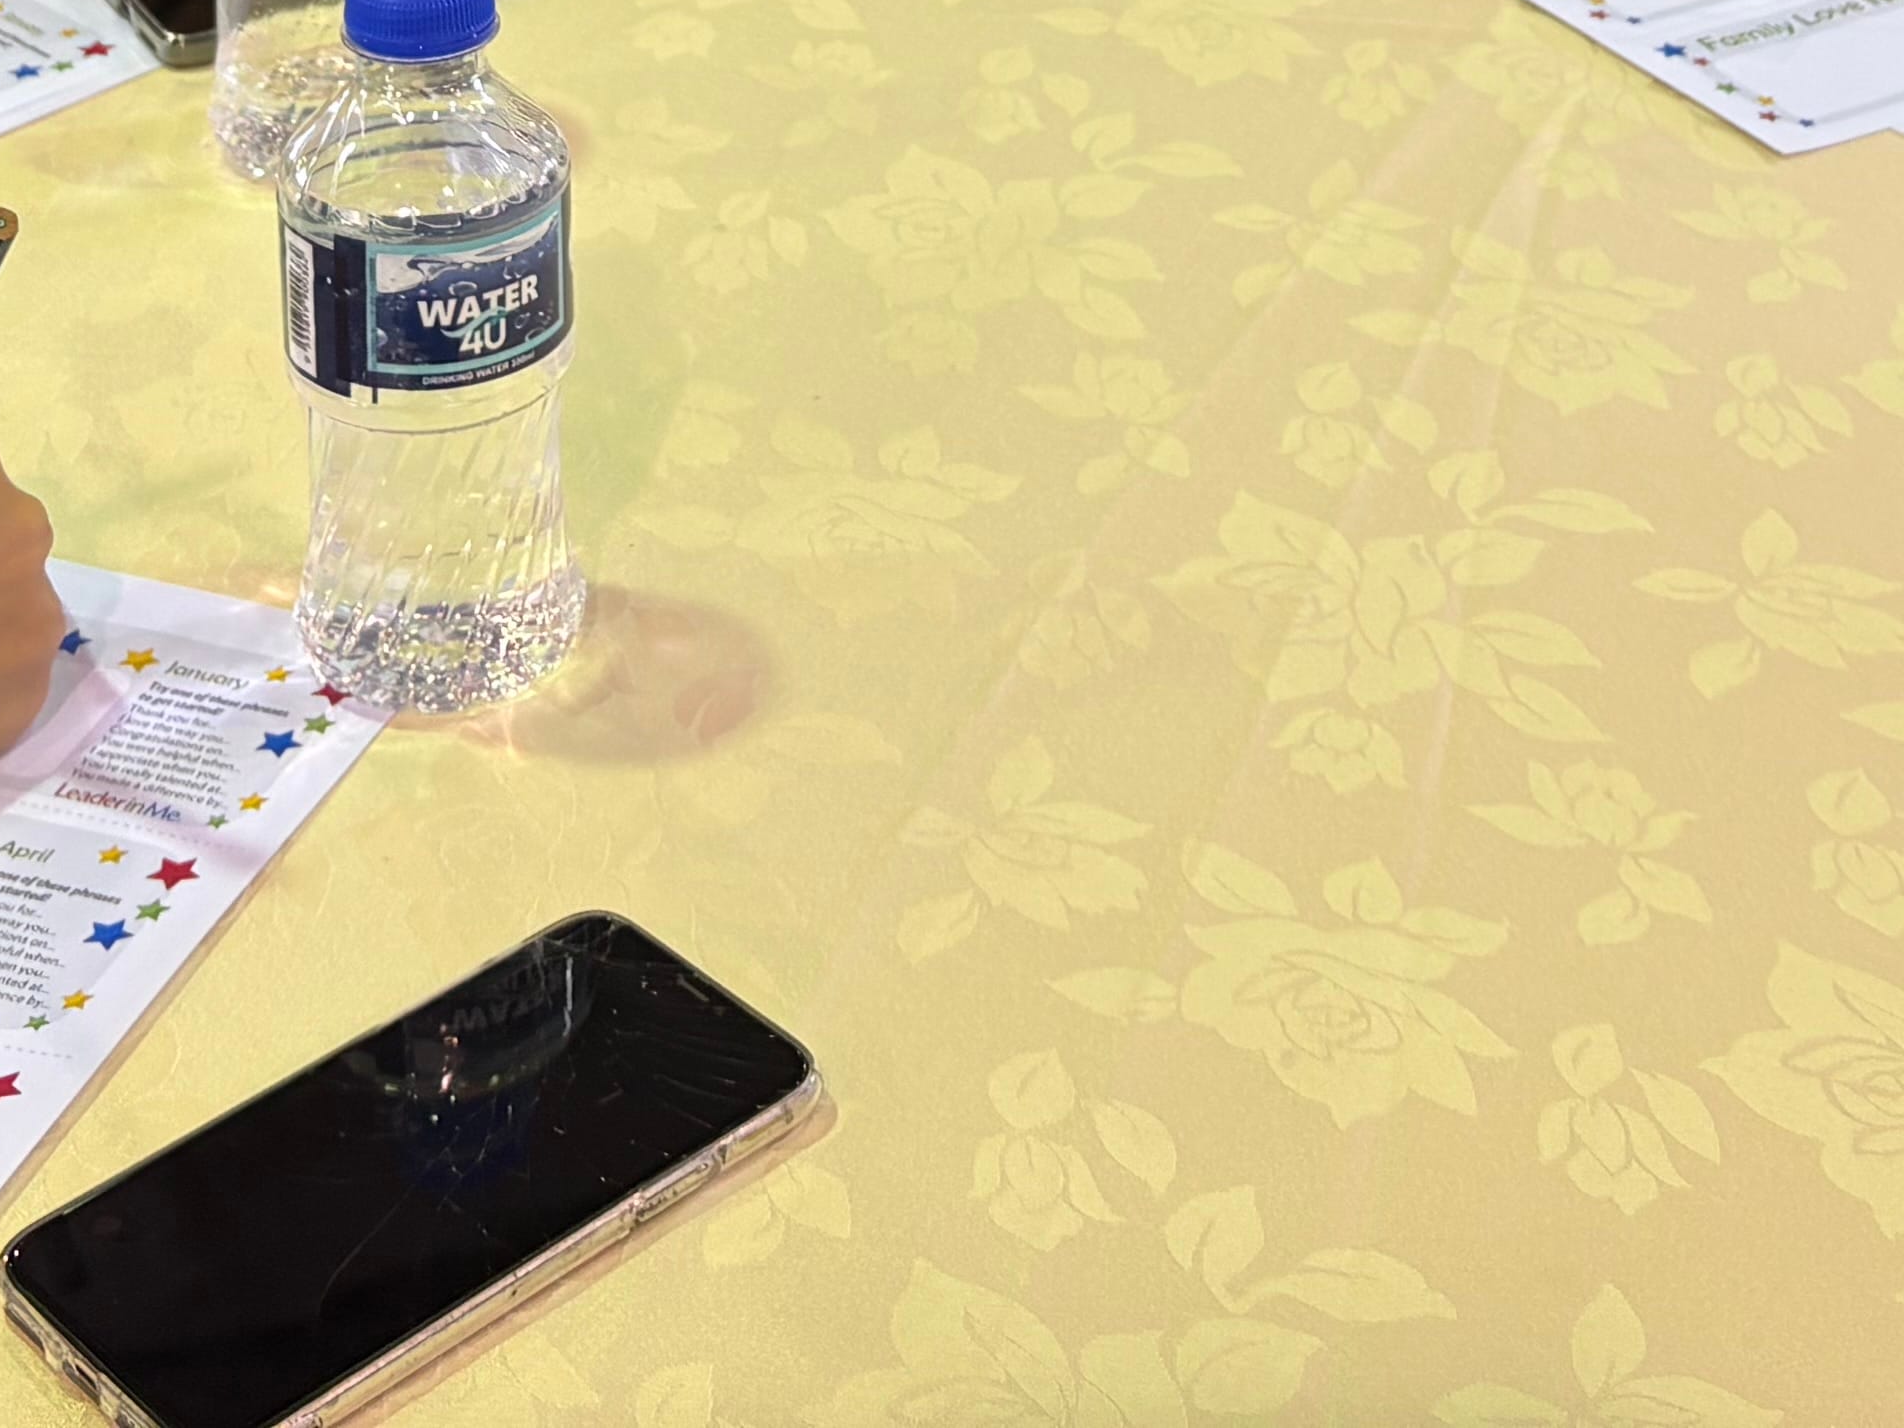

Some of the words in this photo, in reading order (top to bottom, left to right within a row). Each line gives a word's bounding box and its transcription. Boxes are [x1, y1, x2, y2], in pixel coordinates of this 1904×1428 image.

[1696, 18, 1796, 54] Family
[417, 274, 538, 327] WATER
[459, 318, 507, 354] 4U
[422, 371, 474, 385] DRINKING
[476, 363, 509, 378] WATER
[164, 660, 247, 689] January
[55, 783, 180, 822] LeaderinMe
[19, 875, 39, 887] of
[35, 878, 71, 893] these
[68, 887, 121, 905] phrases
